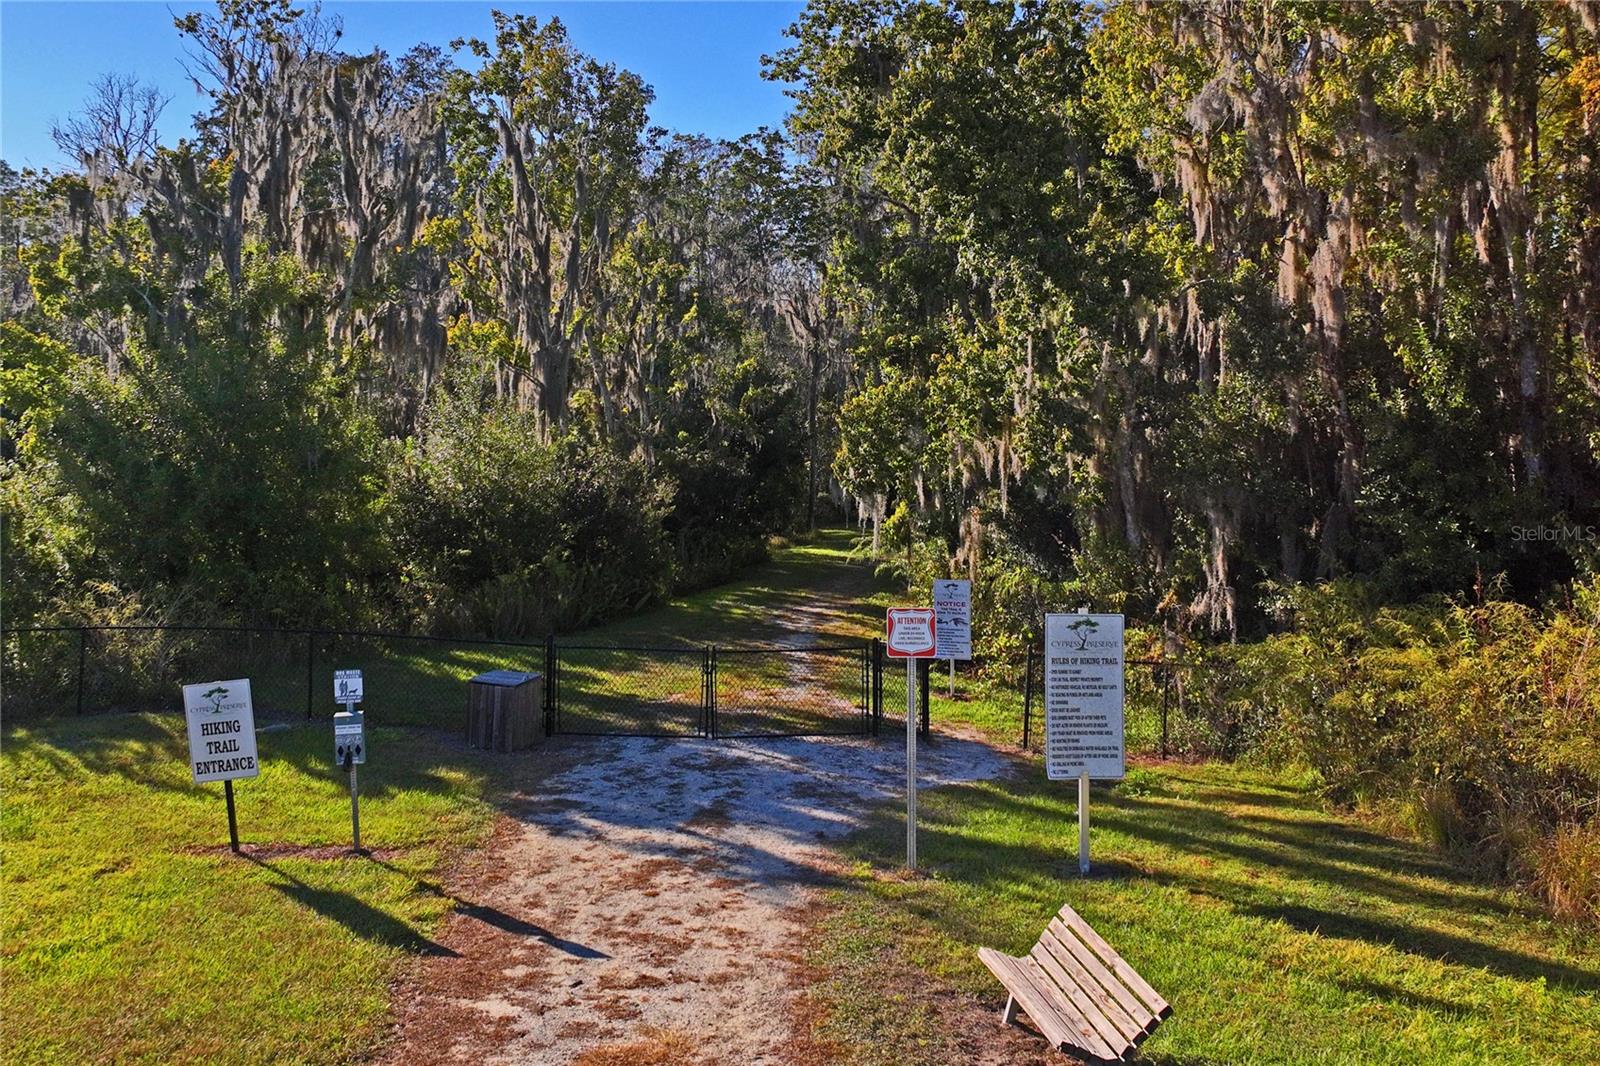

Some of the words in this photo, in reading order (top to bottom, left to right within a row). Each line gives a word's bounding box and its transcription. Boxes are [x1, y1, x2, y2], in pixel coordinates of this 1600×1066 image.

[1051, 657, 1069, 665] RULES
[1070, 657, 1079, 665] OF
[1080, 657, 1100, 665] HIKING
[1101, 657, 1119, 665] TRAIL
[190, 706, 216, 714] CYPRESS
[220, 702, 247, 710] PRESERVE
[201, 720, 241, 736] HIKING
[206, 739, 240, 755] TRAIL
[195, 756, 255, 775] ENTRANCE
